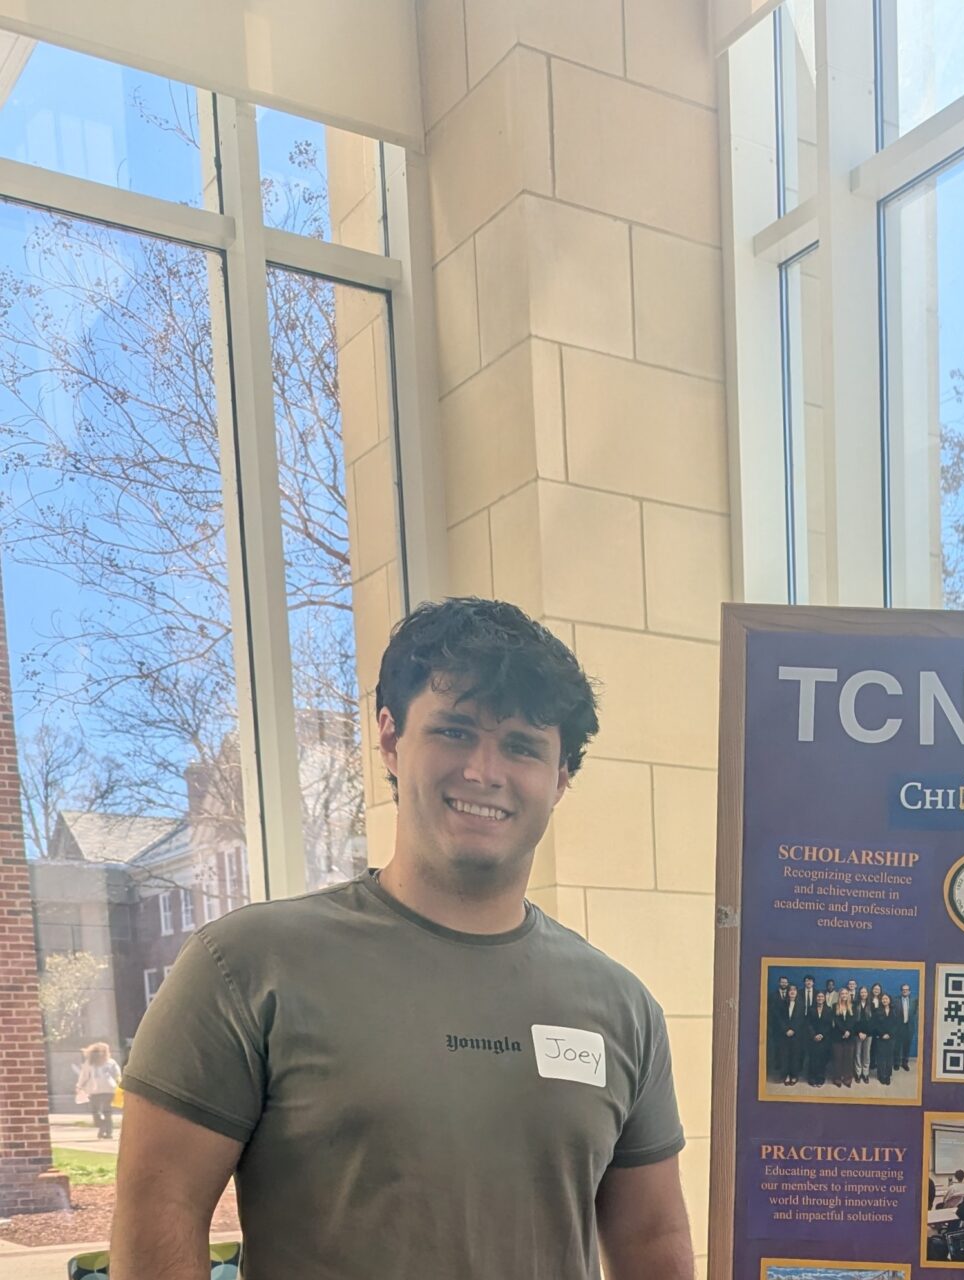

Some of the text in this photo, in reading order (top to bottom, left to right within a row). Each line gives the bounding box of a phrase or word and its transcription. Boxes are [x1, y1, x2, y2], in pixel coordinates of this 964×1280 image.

[900, 782, 956, 810] CHI
[778, 844, 919, 867] SCHOLARSHIP
[784, 866, 912, 884] Recognizing excellence
[794, 884, 814, 894] and
[816, 885, 886, 899] achievement
[774, 899, 918, 917] academic and professional
[817, 917, 872, 930] endeavors
[446, 1034, 522, 1054] Youngla
[545, 1037, 602, 1074] Joey
[761, 1144, 907, 1162] PRACTICALITY
[765, 1165, 904, 1180] Educating and encouraging
[761, 1181, 907, 1195] our members to improve our
[769, 1195, 898, 1208] world through innovative
[773, 1210, 893, 1223] and impactful solutions
